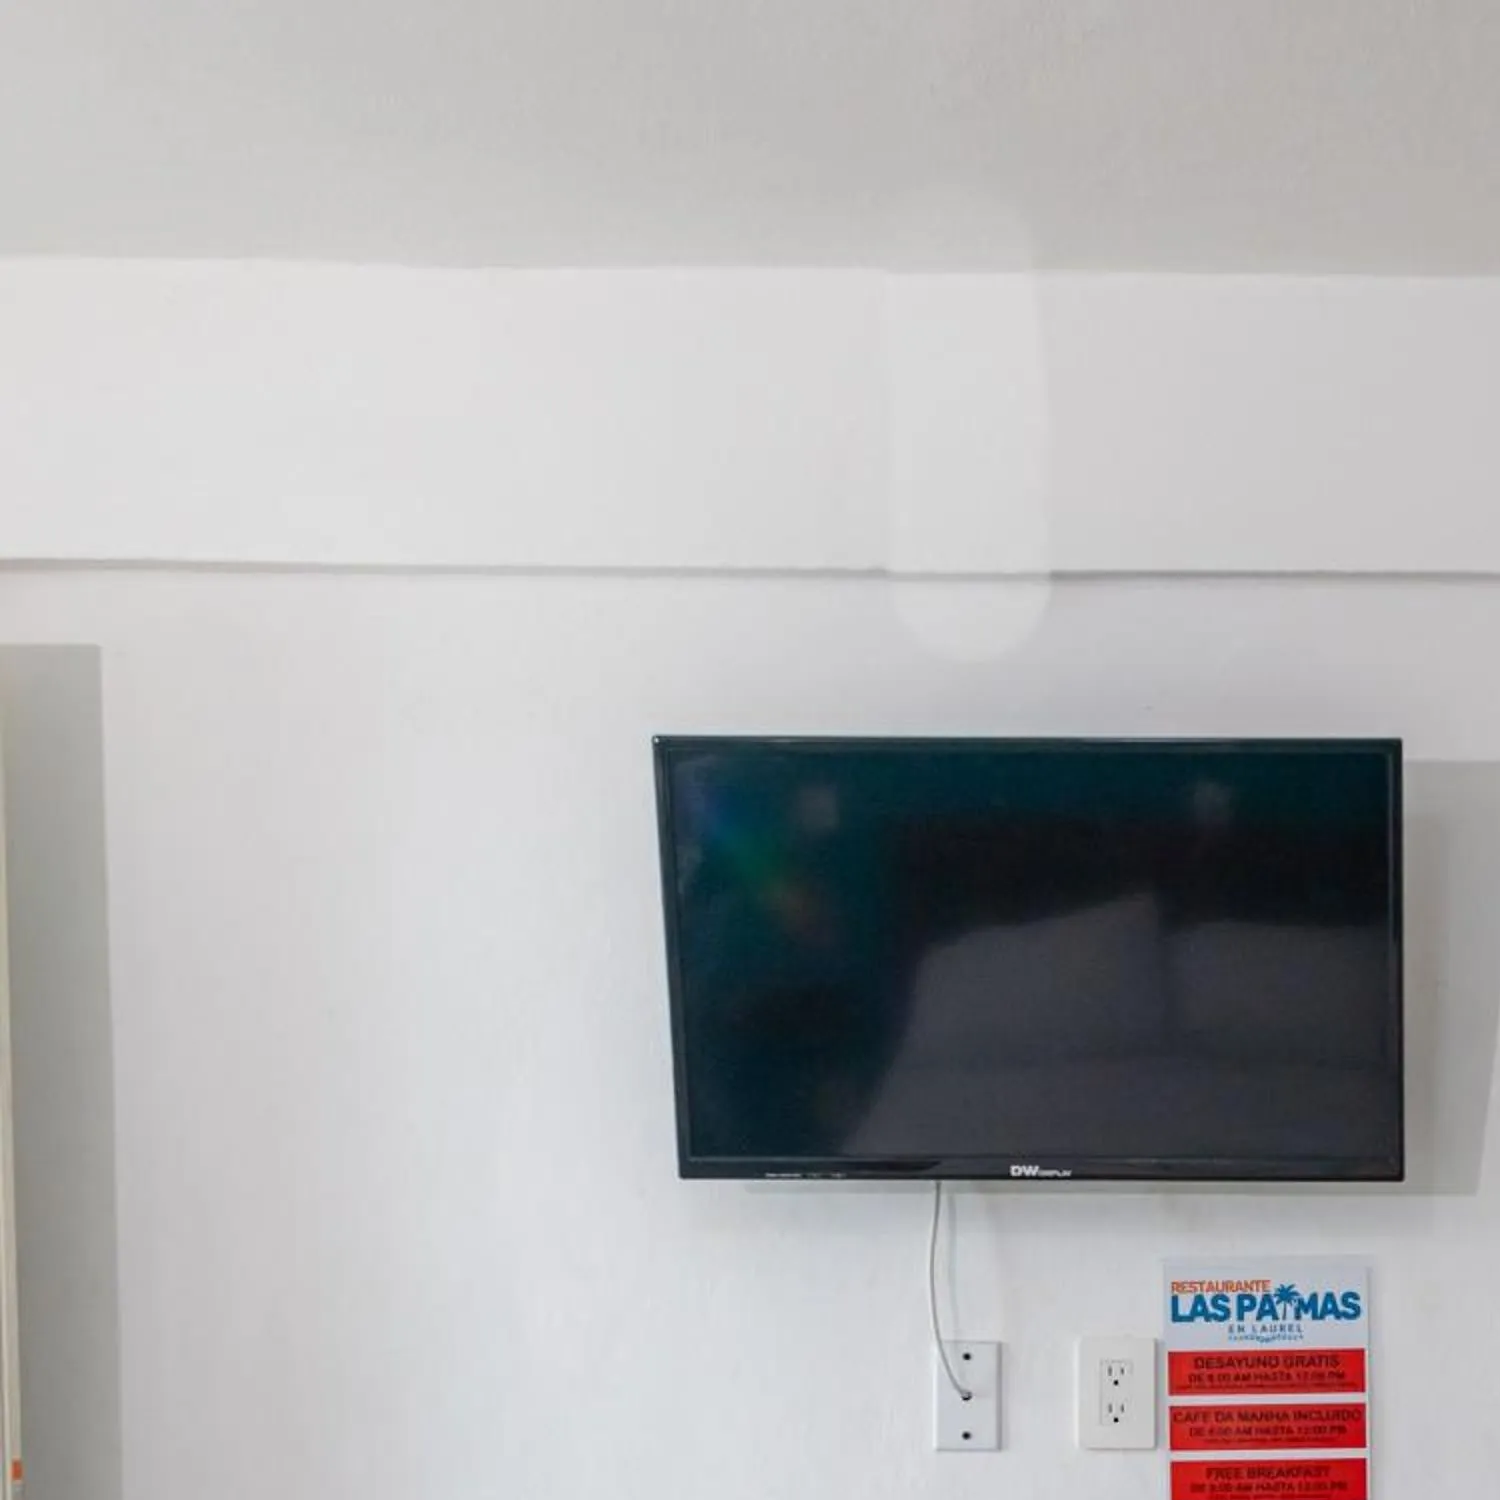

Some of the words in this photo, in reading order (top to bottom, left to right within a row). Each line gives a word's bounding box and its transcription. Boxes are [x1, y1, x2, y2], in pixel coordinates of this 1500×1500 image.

[1171, 1280, 1271, 1294] RESTAURANTE
[1171, 1293, 1231, 1323] LAS
[1237, 1284, 1361, 1322] PAMAS
[1252, 1322, 1304, 1333] LAUREL
[1194, 1355, 1280, 1370] DESAYUNO
[1283, 1353, 1340, 1369] GRATIS
[1254, 1371, 1293, 1382] HASTA
[1294, 1408, 1361, 1422] INCLUIDO
[1255, 1425, 1295, 1436] HASTA
[1206, 1467, 1245, 1481] FREE
[1247, 1464, 1331, 1479] BREAKFAST
